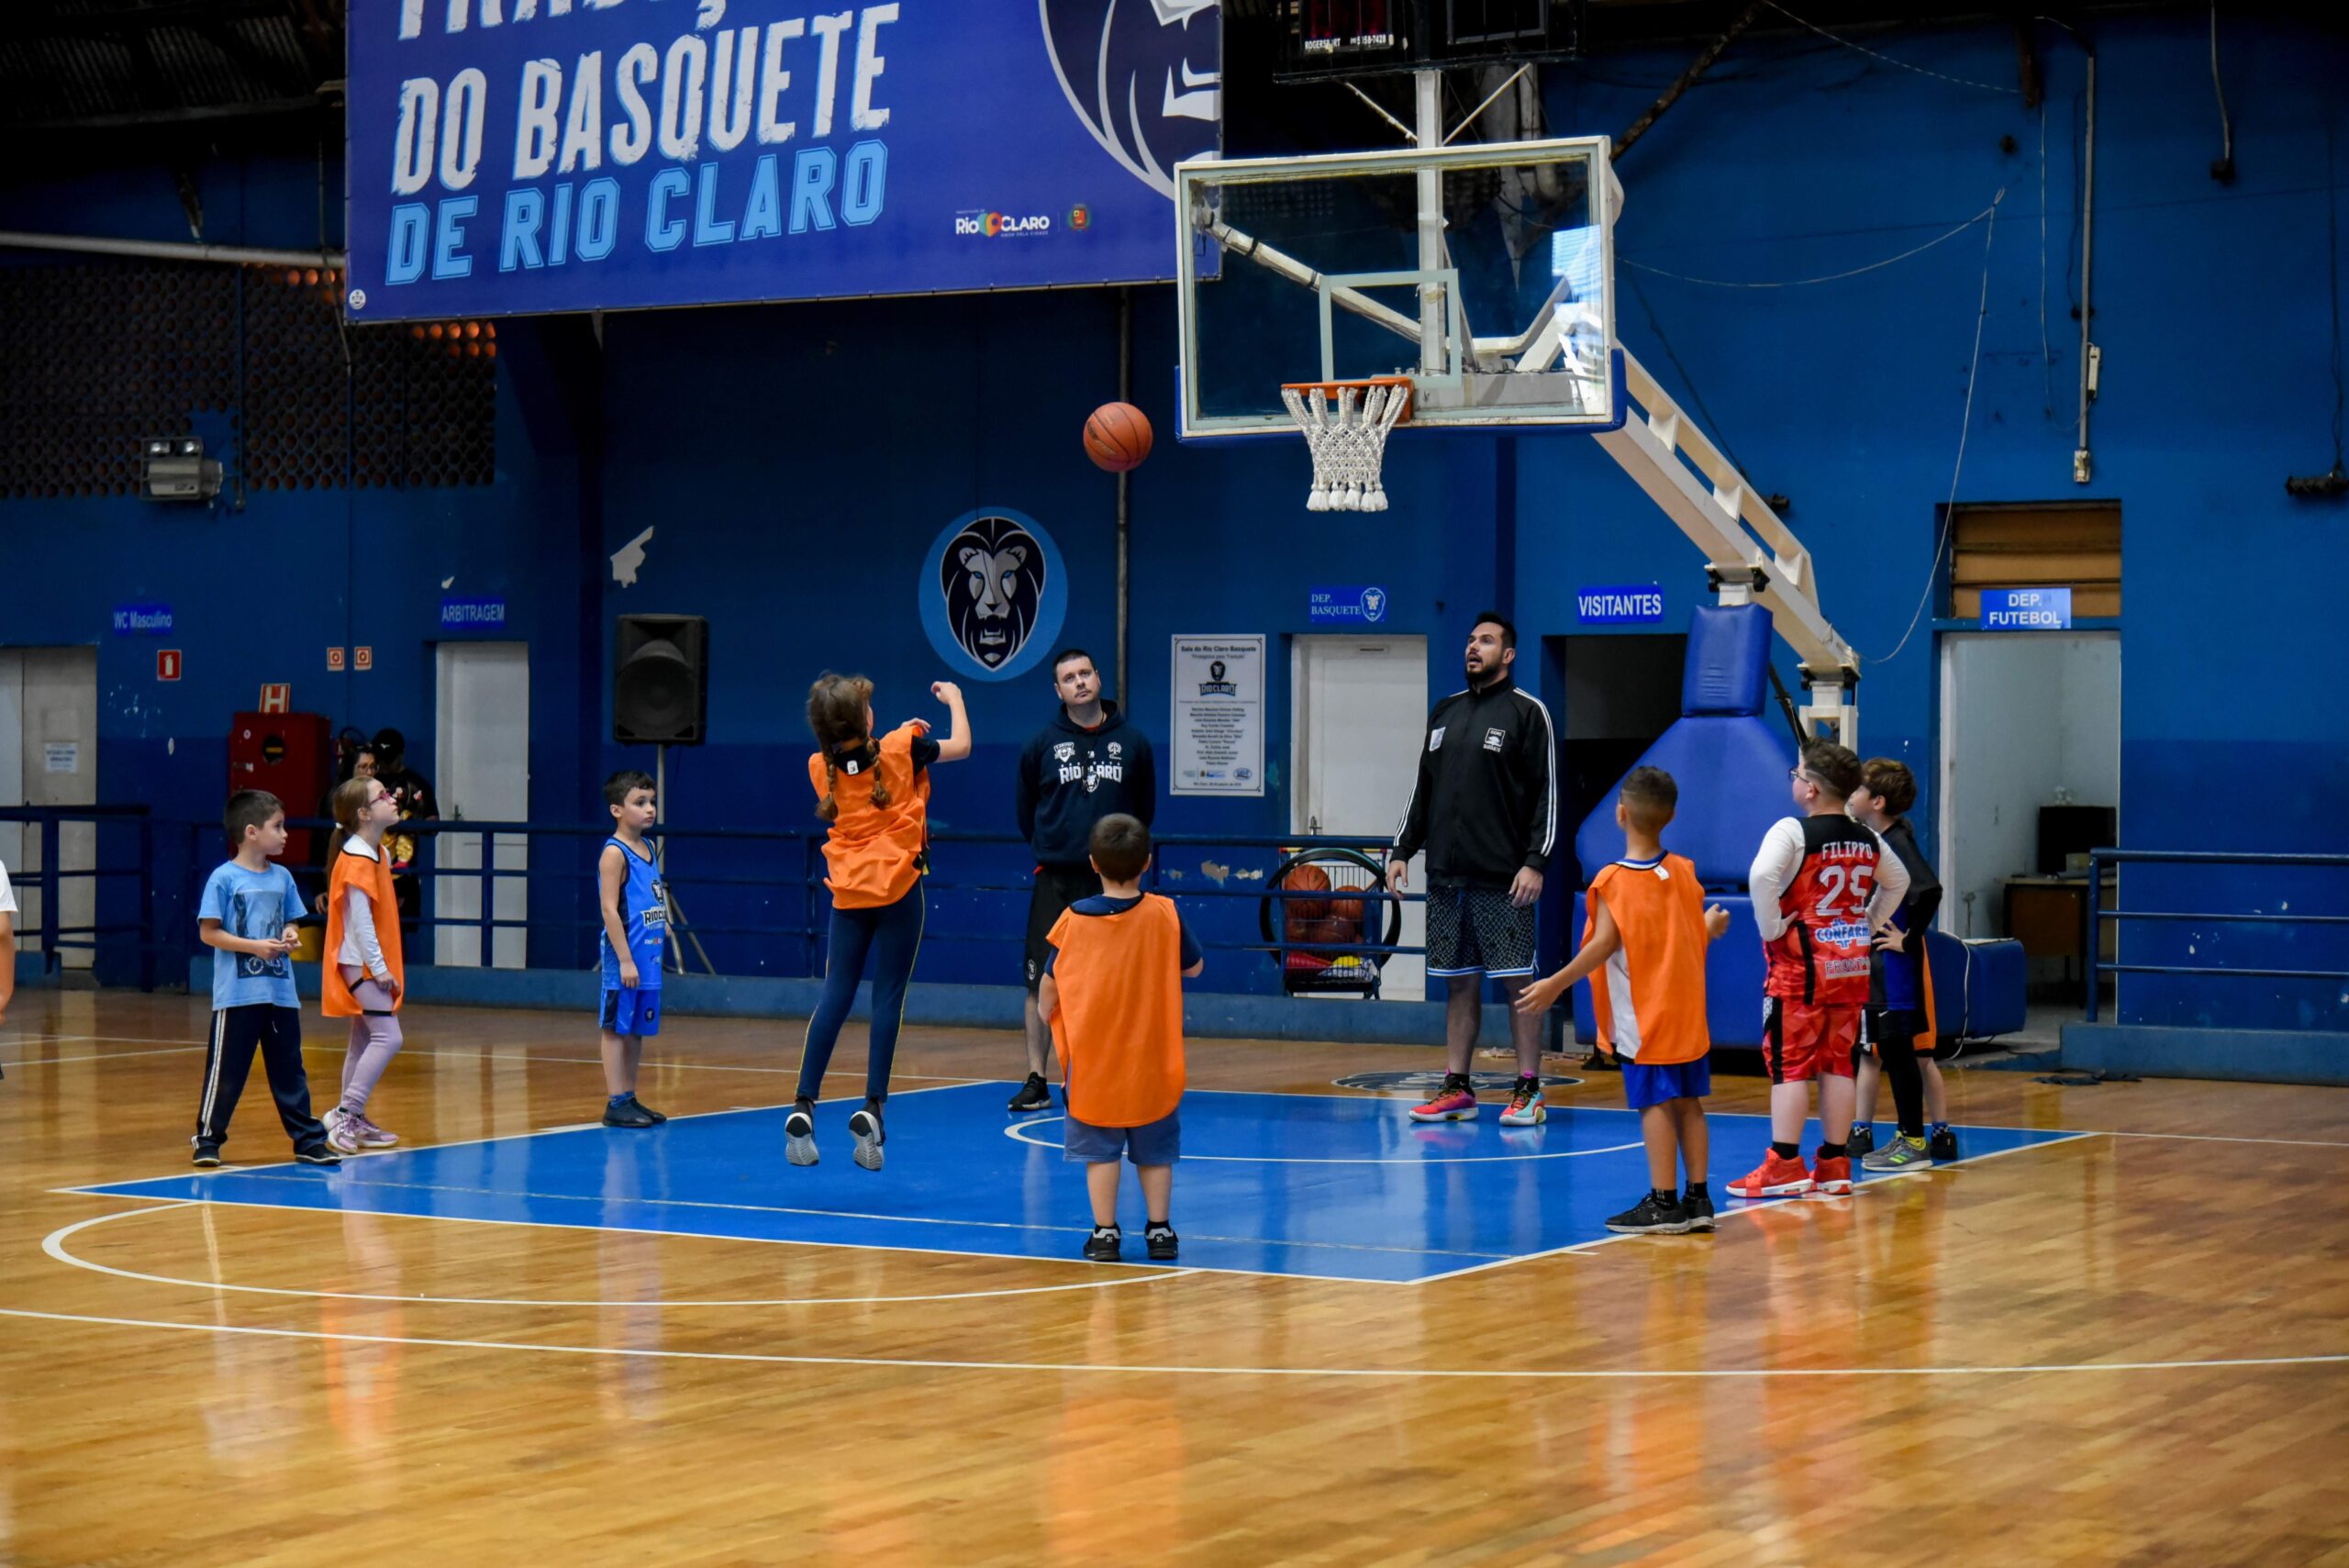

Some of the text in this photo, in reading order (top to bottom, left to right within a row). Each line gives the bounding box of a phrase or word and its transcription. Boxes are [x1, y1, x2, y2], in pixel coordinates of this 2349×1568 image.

[1305, 38, 1341, 50] ROGERSPRT
[391, 3, 900, 196] DO BASQUETE
[384, 139, 888, 286] DE RIO CLARO
[1311, 594, 1332, 603] DEP.
[1578, 594, 1662, 617] VISITANTES
[2008, 594, 2042, 607] DEP.
[113, 609, 173, 629] WC Masculino
[441, 604, 505, 622] ARBITRAGEM
[1311, 606, 1362, 617] BASQUETE
[1988, 611, 2063, 625] FUTEBOL
[1230, 645, 1256, 653] Basquete
[264, 685, 286, 713] H
[1821, 840, 1873, 860] FILIPPO
[1815, 864, 1874, 917] 25
